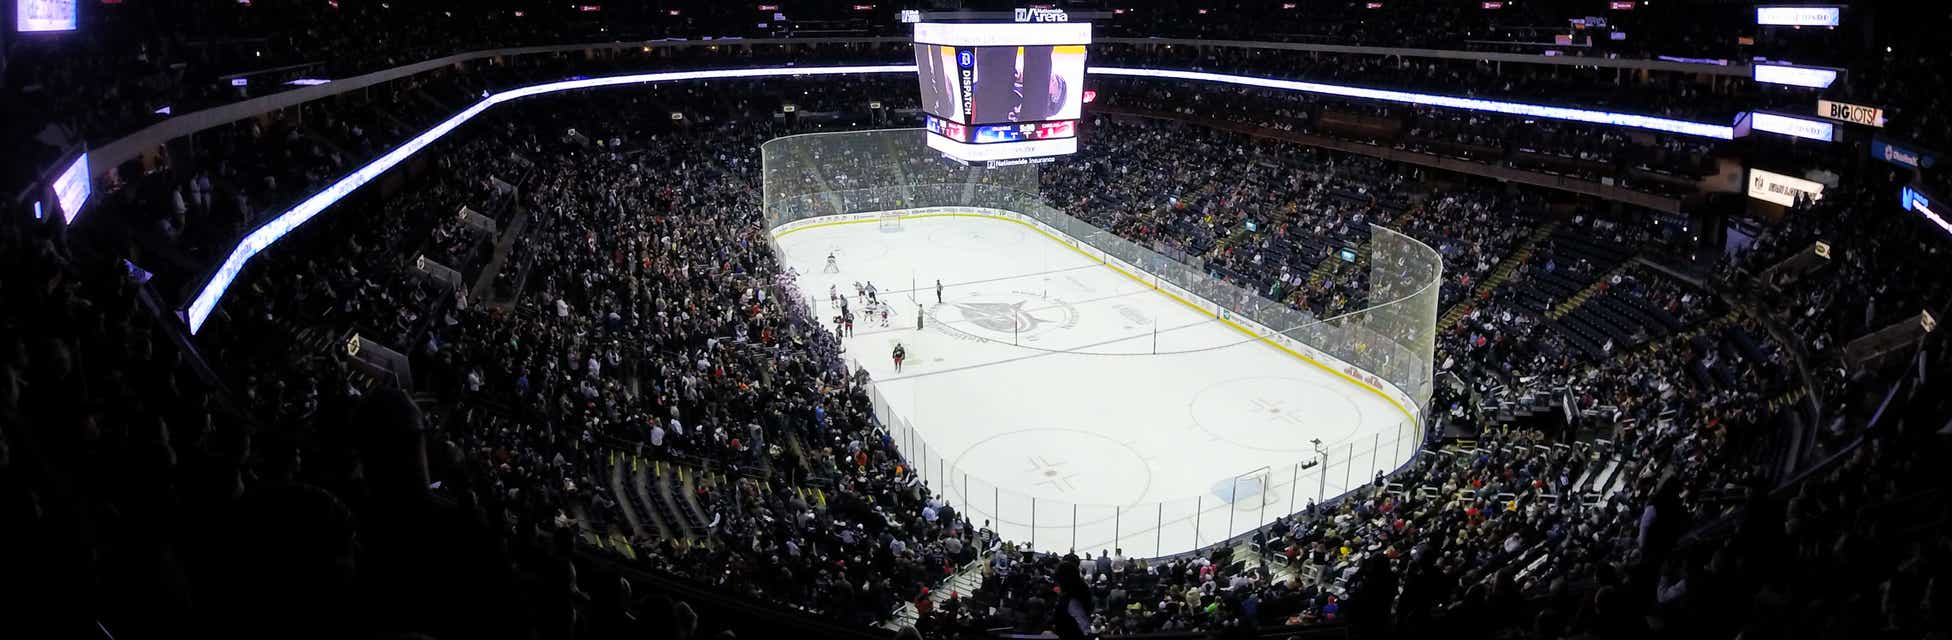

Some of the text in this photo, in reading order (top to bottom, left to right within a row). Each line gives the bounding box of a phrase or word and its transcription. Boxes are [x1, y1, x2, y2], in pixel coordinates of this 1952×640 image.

[1027, 8, 1068, 22] Arena
[962, 70, 972, 115] DISPATCH
[995, 158, 1028, 166] Nationwide
